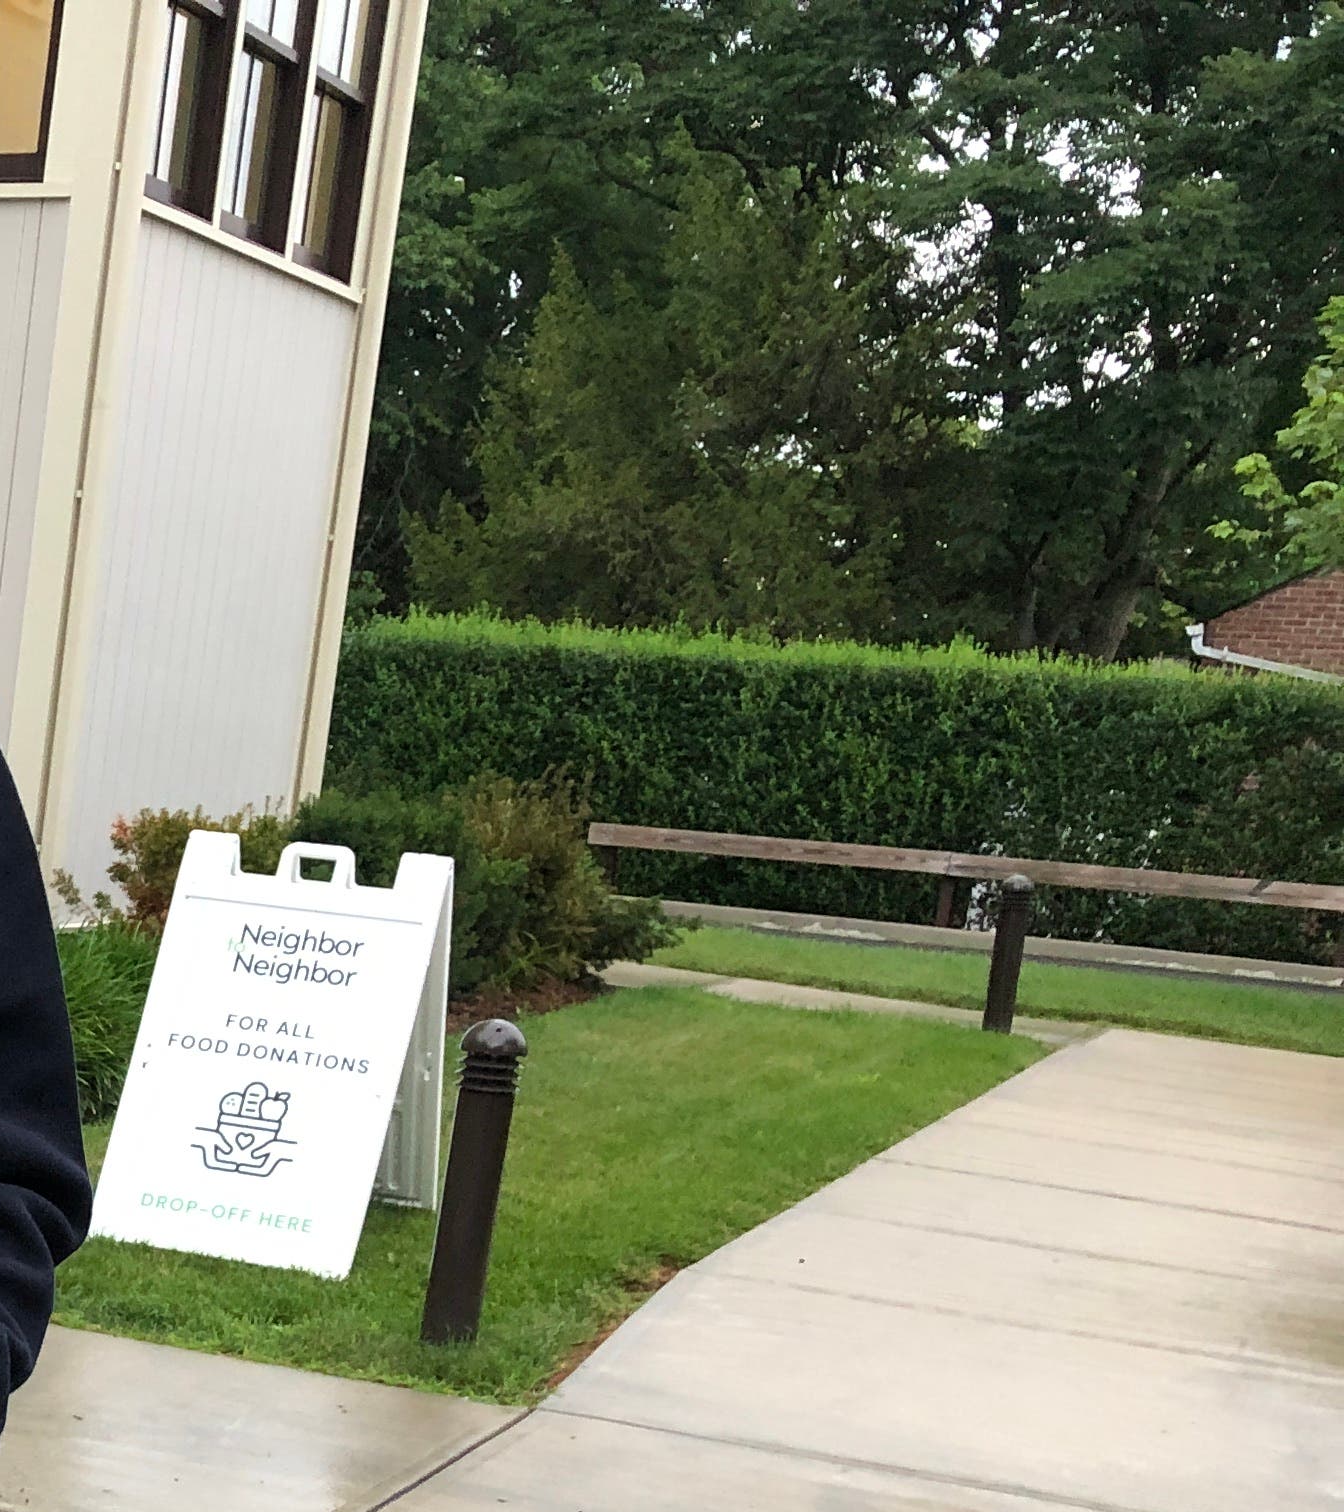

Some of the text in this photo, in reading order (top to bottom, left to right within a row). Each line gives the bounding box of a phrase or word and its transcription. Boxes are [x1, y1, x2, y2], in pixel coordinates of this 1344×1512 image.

[239, 921, 365, 958] Neighbor
[232, 951, 358, 987] Neighbor
[224, 1013, 316, 1041] FOR ALL
[167, 1032, 371, 1075] FOOD DONATIONS
[139, 1191, 314, 1235] DROP-OFF HERE
